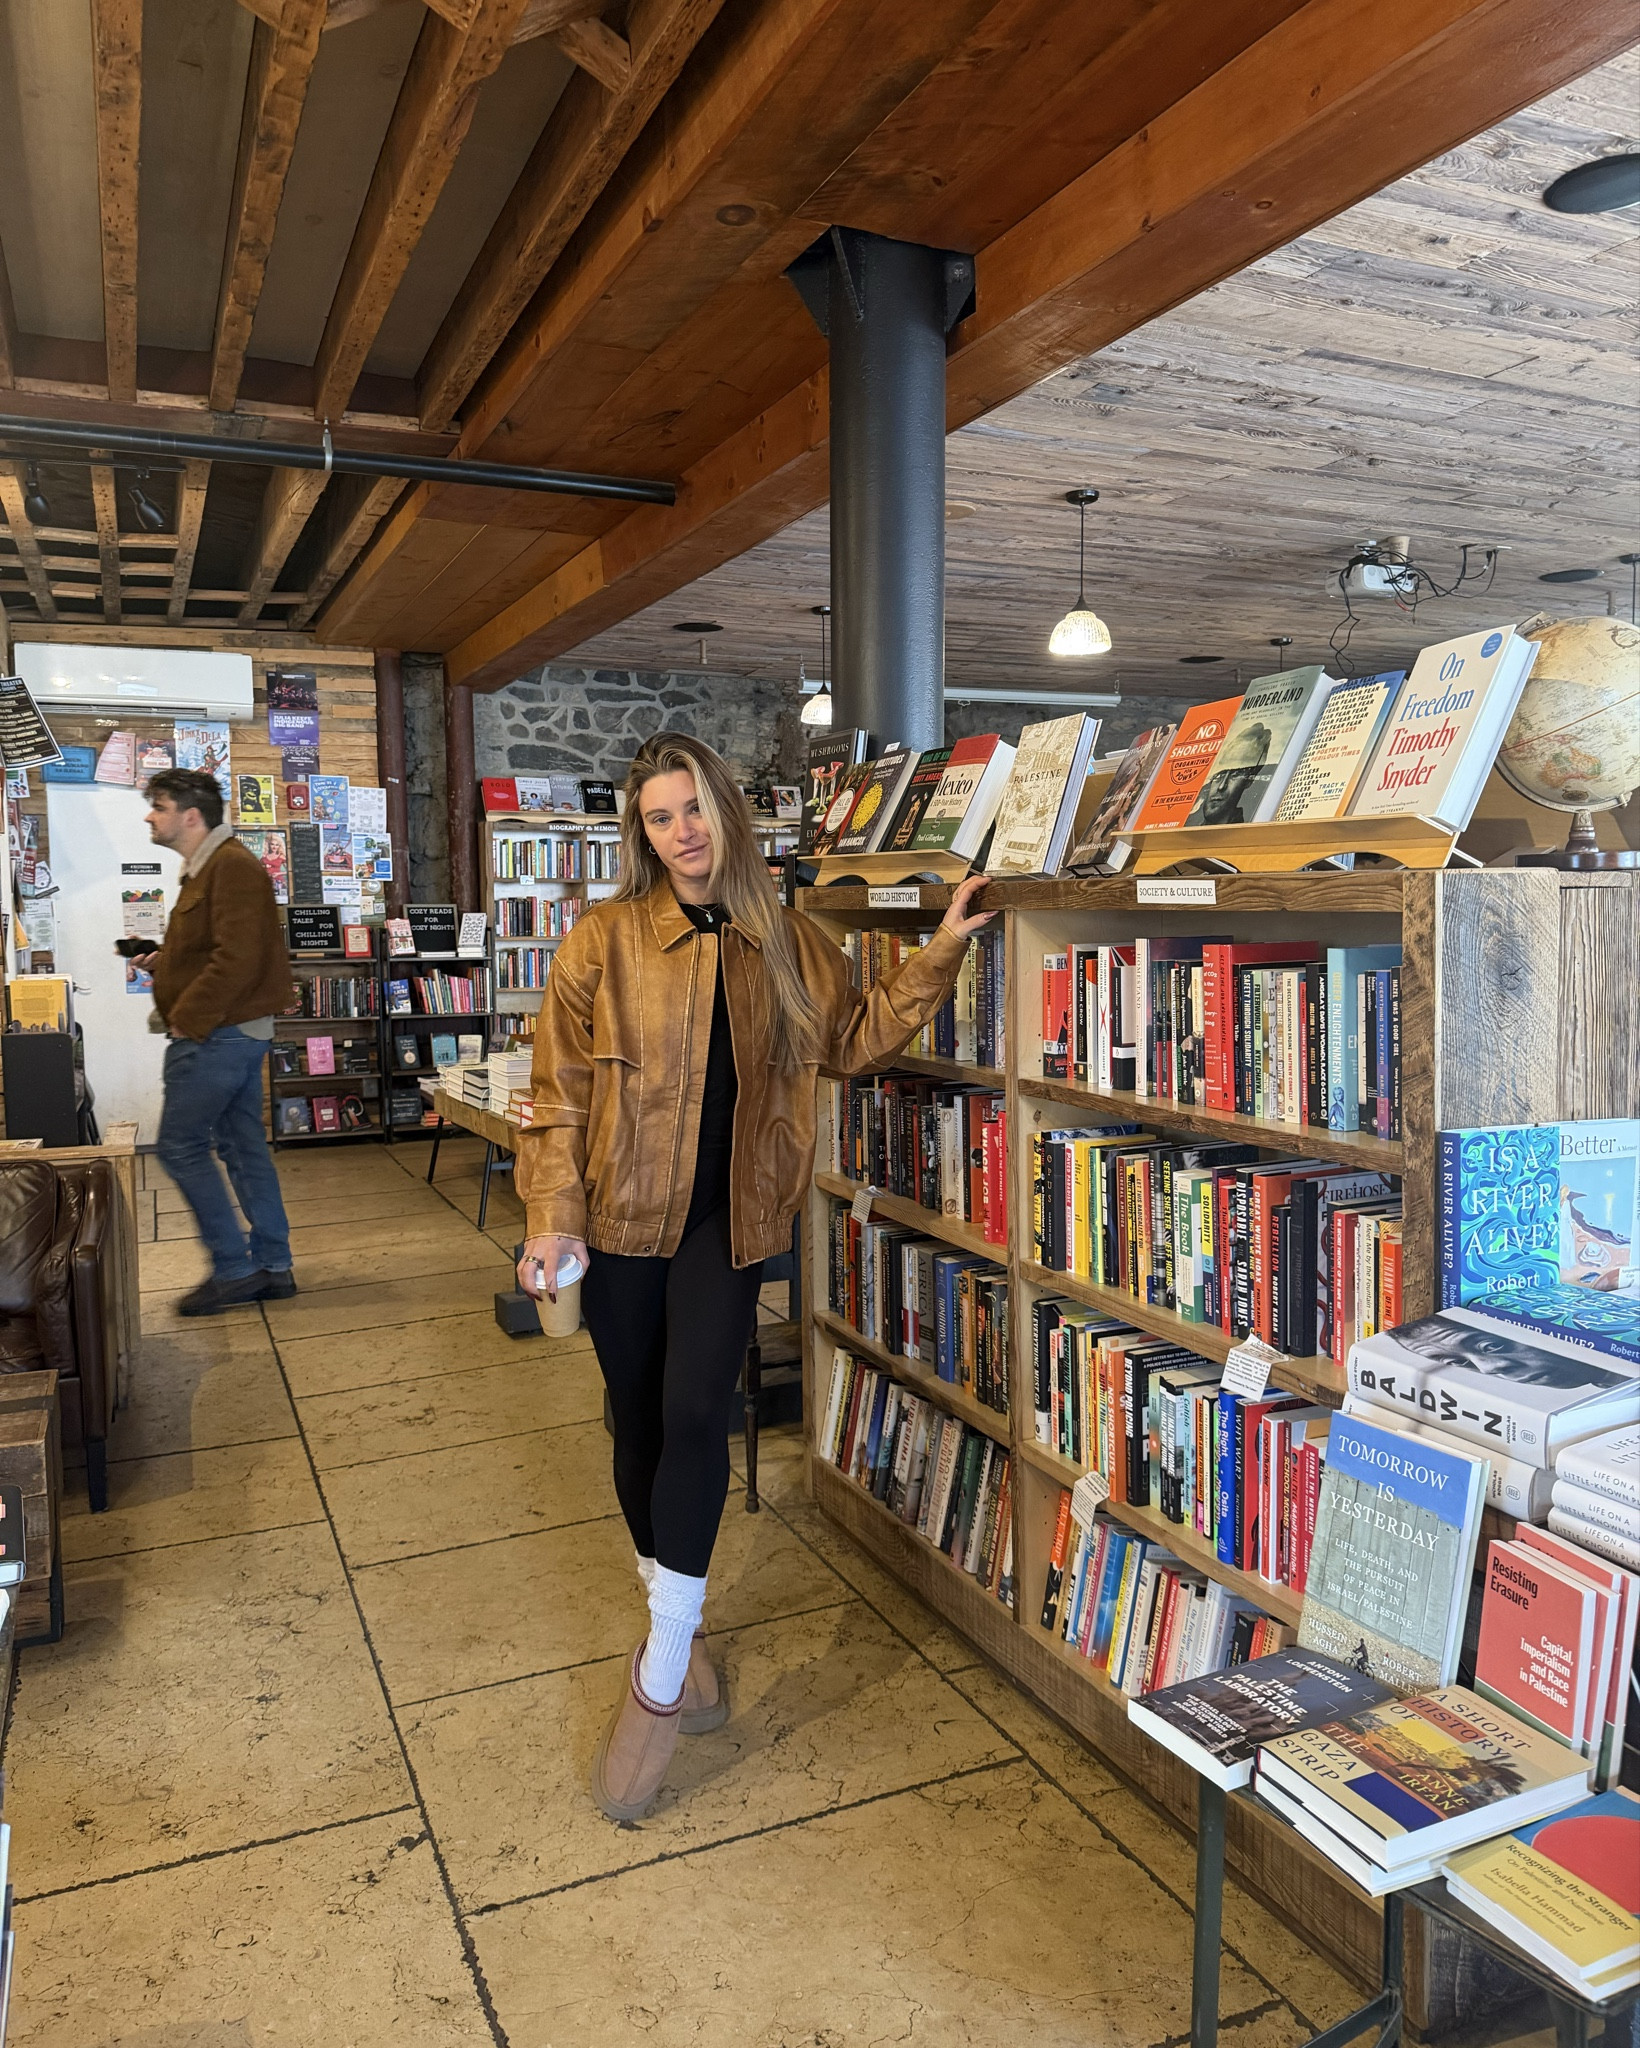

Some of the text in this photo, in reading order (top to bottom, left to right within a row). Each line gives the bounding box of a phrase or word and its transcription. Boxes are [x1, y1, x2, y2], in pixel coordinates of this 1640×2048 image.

[1440, 652, 1465, 682] On
[1240, 687, 1304, 711] MURDERLAND
[1398, 684, 1475, 722] Freedom
[1196, 724, 1217, 739] NO
[1387, 717, 1460, 757] Timothy
[810, 742, 850, 758] MUSHROOMS
[1174, 757, 1210, 769] ORGANIZING
[1311, 749, 1360, 762] PERILOUS TIMES
[1316, 746, 1338, 756] POETRY
[586, 788, 612, 796] PADELLA
[935, 773, 973, 797] Mexico
[1014, 768, 1062, 785] PALESTINE
[1177, 769, 1198, 782] POWER
[1318, 781, 1340, 790] TRACY
[1323, 787, 1343, 795] SMITH
[1376, 756, 1438, 799] Snyder
[870, 891, 918, 904] WORLD HISTORY
[1139, 887, 1214, 897] SOCIETY & CULTURE
[1243, 974, 1251, 997] SAFETY
[1243, 1000, 1251, 1029] THROUGH
[1332, 1003, 1342, 1084] ENLIGHTENMENTS
[1254, 1067, 1262, 1094] CHAYKA
[1488, 1144, 1540, 1173] IS A
[1561, 1134, 1617, 1156] Better
[1162, 1160, 1171, 1193] SEEKING
[1322, 1183, 1386, 1204] FIREHOSE
[1163, 1195, 1172, 1229] SHELTER
[1443, 1141, 1453, 1269] IS A RIVER ALIVE?
[1471, 1183, 1553, 1215] RIVER
[1180, 1197, 1190, 1253] The Book
[1202, 1194, 1211, 1244] SOLIDARITY
[1236, 1181, 1248, 1327] DISPOSABLE SARAH JONES
[1271, 1215, 1279, 1271] REBELLION
[1465, 1221, 1559, 1256] ALIVE?
[919, 1256, 927, 1318] AFRICA
[1165, 1260, 1173, 1287] HOBBS
[1384, 1256, 1394, 1295] TYRANNY
[1486, 1272, 1540, 1293] Robert
[1124, 1357, 1133, 1438] BEYOND POLICING
[1361, 1370, 1503, 1437] BALDWIN
[901, 1397, 917, 1462] HIROSHIMA
[1107, 1386, 1116, 1473] NO SHORTCUTS
[1220, 1409, 1229, 1457] The Right
[1338, 1435, 1450, 1490] TOMORROW
[1376, 1482, 1395, 1502] IS
[1563, 1471, 1631, 1502] LITTLE-KNOWN
[1593, 1470, 1635, 1492] LIFE ON A
[1329, 1491, 1439, 1552] YESTERDAY
[1335, 1537, 1419, 1583] LIFE, DEATH, AND
[1343, 1557, 1405, 1592] THE PURSUIT
[1343, 1573, 1400, 1607] OF PEACE IN
[1490, 1575, 1529, 1610] Erasure
[1492, 1556, 1539, 1599] Resisting
[1327, 1581, 1413, 1630] ISRAEL/PALESTINE
[1308, 1617, 1348, 1644] HUSSEIN
[1313, 1635, 1339, 1655] AGHA
[1381, 1654, 1421, 1681] ROBERT
[1520, 1637, 1571, 1678] Imperialism
[1541, 1635, 1574, 1666] Capital,
[1268, 1678, 1298, 1697] THE
[1285, 1658, 1353, 1694] LOEWENSTEIN
[1306, 1660, 1351, 1682] ANTONY
[1379, 1669, 1420, 1697] MALLEY
[1520, 1667, 1568, 1708] in Palestine
[1530, 1661, 1570, 1693] and Race
[1213, 1676, 1301, 1725] LABORATORY
[1230, 1673, 1308, 1717] PALESTINE
[1389, 1704, 1423, 1721] OF
[1409, 1698, 1513, 1760] HISTORY
[1429, 1693, 1532, 1751] A SHORT
[1300, 1731, 1358, 1772] GAZA
[1323, 1724, 1370, 1755] THE
[1276, 1738, 1341, 1780] STRIP
[1398, 1773, 1456, 1811] IRFAN
[1415, 1771, 1470, 1807] ANNE
[1490, 1867, 1532, 1896] Isabella
[1531, 1894, 1588, 1934] Hammad
[1506, 1844, 1566, 1886] Recognizing
[1566, 1882, 1586, 1897] the
[1584, 1895, 1634, 1932] Stranger
[1507, 1858, 1605, 1926] On Palestine and Narrative
